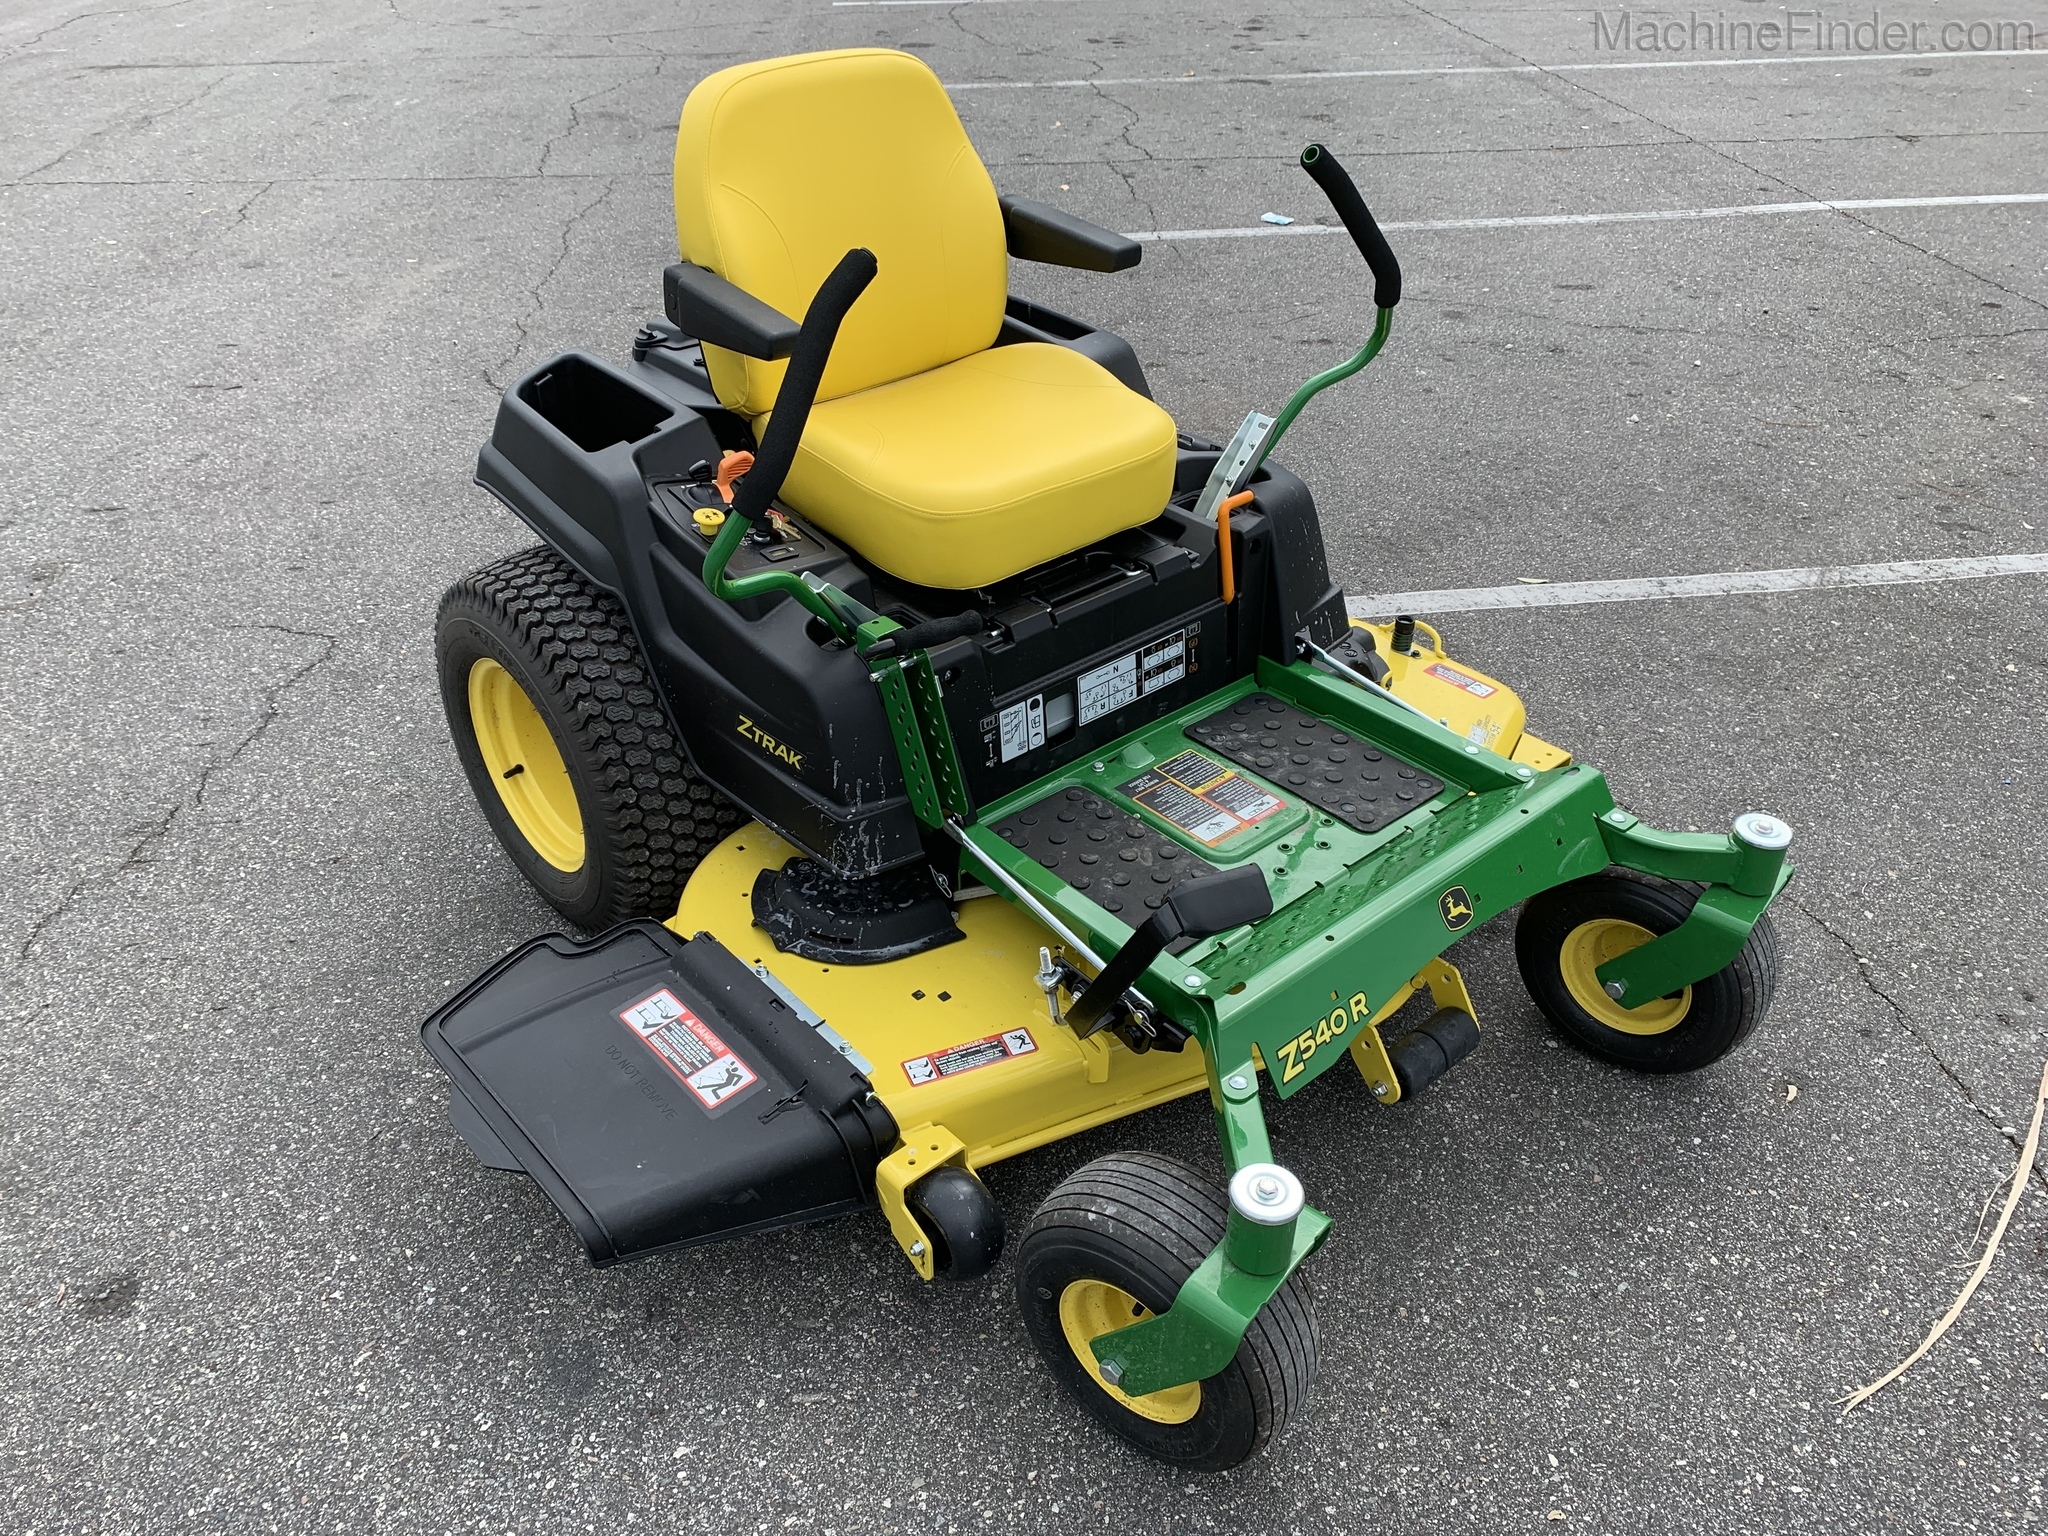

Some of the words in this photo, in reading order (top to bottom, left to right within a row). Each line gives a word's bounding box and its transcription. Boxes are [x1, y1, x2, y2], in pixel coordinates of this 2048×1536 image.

[736, 714, 803, 771] ZTRAK
[692, 1023, 725, 1052] DANGER
[953, 1039, 985, 1051] DANGER
[604, 1044, 622, 1061] DO
[617, 1060, 641, 1080] NOT
[635, 1076, 679, 1122] REMOVE
